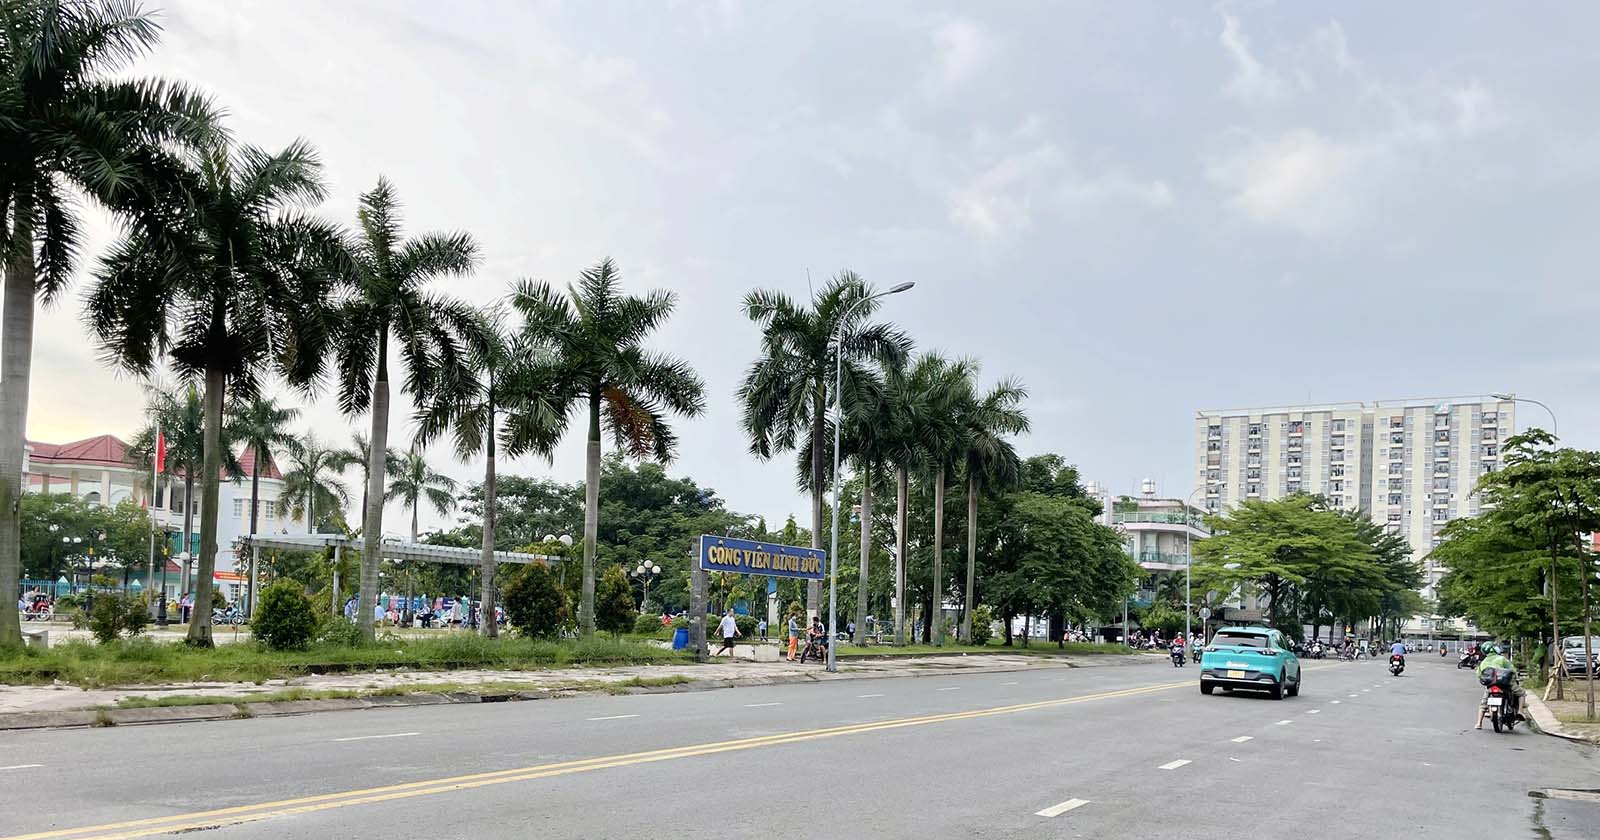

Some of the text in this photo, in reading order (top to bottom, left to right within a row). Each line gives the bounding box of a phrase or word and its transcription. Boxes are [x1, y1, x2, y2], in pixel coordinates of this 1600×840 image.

[708, 540, 821, 574] CÔNG VIÊN BÌNH ĐỨC
